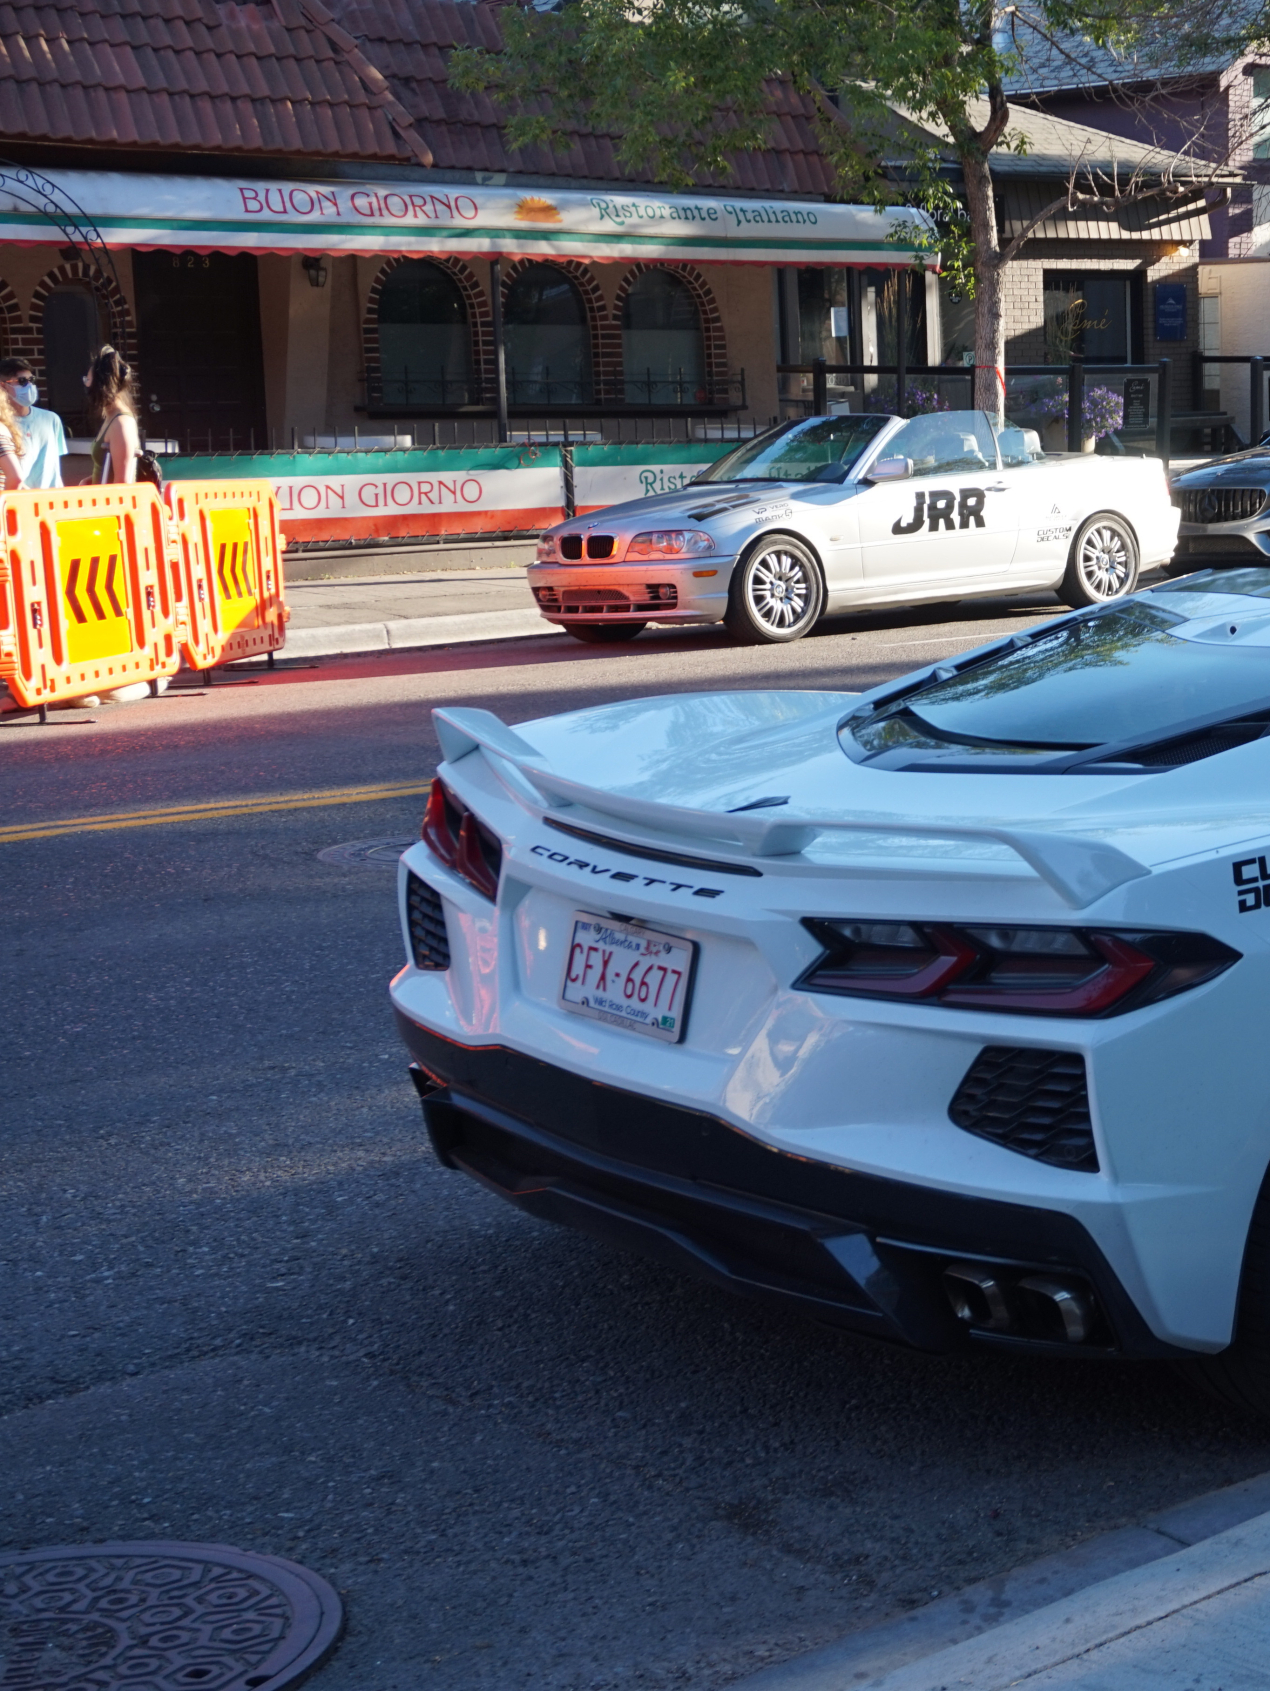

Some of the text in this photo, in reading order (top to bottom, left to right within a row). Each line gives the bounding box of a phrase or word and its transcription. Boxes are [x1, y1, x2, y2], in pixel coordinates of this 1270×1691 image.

[237, 187, 479, 220] BUON GIORNO
[589, 197, 818, 227] Ristorante Italiano
[358, 478, 483, 508] GIORNO
[891, 487, 986, 535] JRR
[1036, 525, 1072, 537] CUSTOM
[1036, 532, 1069, 543] DECALS
[530, 845, 725, 899] CORVETTE
[567, 942, 683, 1012] CFX-6677
[592, 994, 606, 1008] Wild
[625, 1005, 650, 1020] County
